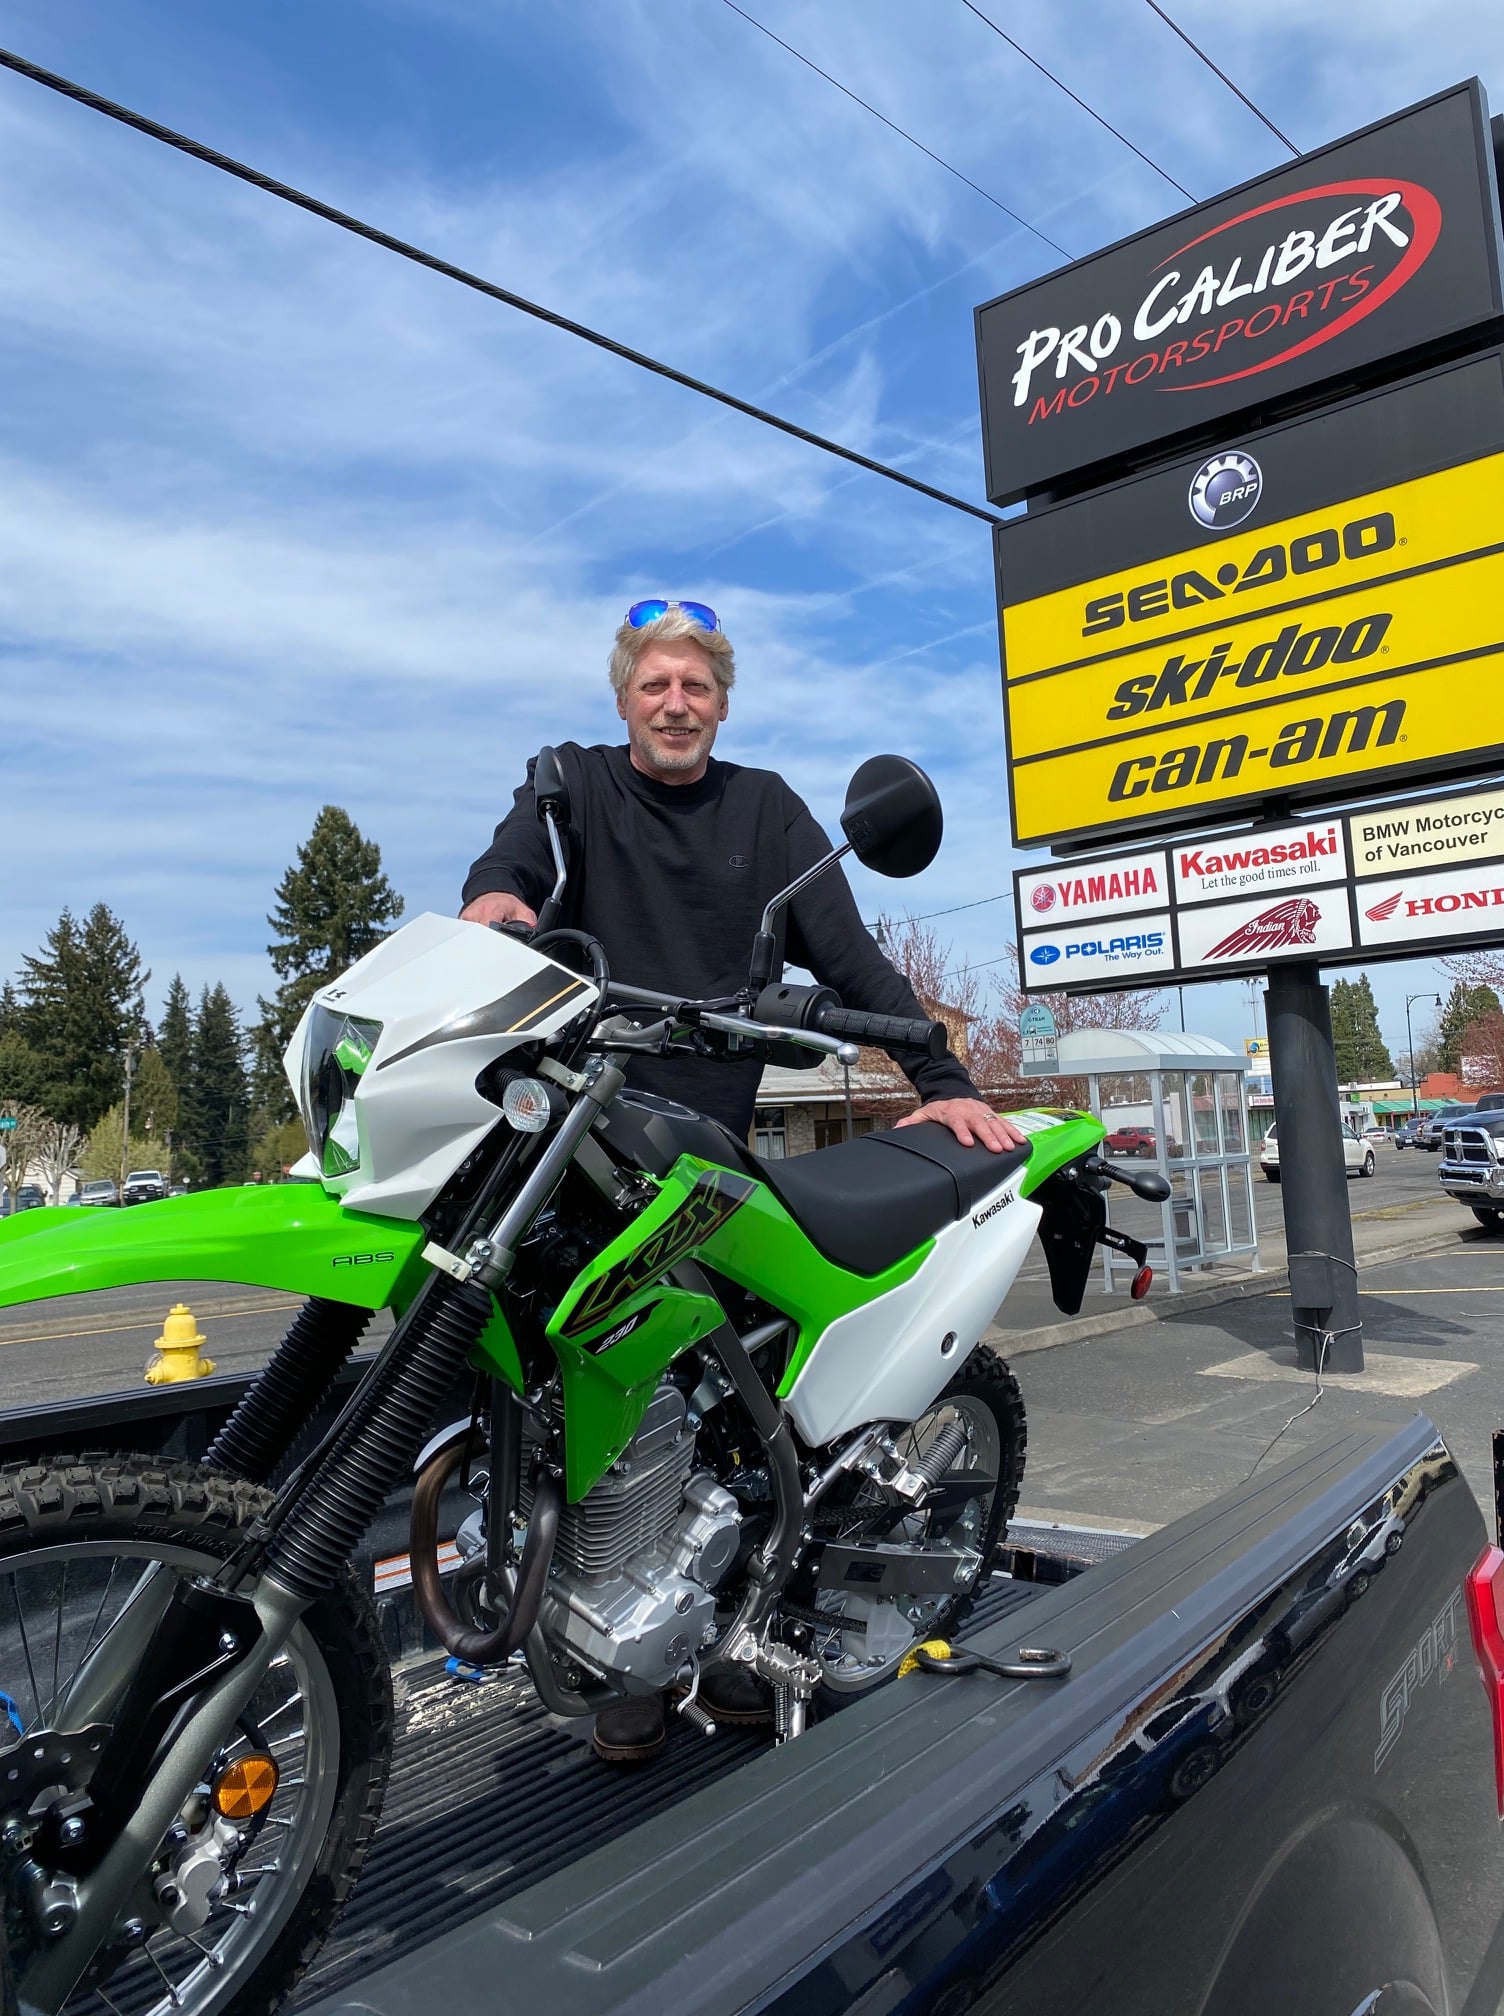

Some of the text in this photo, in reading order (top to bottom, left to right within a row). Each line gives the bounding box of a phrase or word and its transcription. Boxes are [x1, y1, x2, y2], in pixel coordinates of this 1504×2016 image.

[1011, 192, 1409, 407] PRO CALIBER
[1027, 265, 1375, 425] MOTORSPORTS
[1219, 483, 1257, 505] BRP
[1106, 613, 1394, 720] ski-doo
[1107, 699, 1407, 802] can-am
[1363, 820, 1410, 841] BMW
[1365, 831, 1488, 861] of Vancouver
[1180, 828, 1337, 878] Kawasaki
[1057, 867, 1158, 907] YAMAHA
[1201, 860, 1321, 890] Let the good times roll.
[1065, 932, 1164, 958] POLARIS
[1244, 920, 1286, 935] Indian
[1104, 948, 1164, 962] The Way Out.
[971, 1189, 1015, 1230] Kawasaki
[332, 1251, 395, 1267] ABS
[593, 1315, 639, 1355] 230
[1374, 1583, 1462, 1775] SPORT
